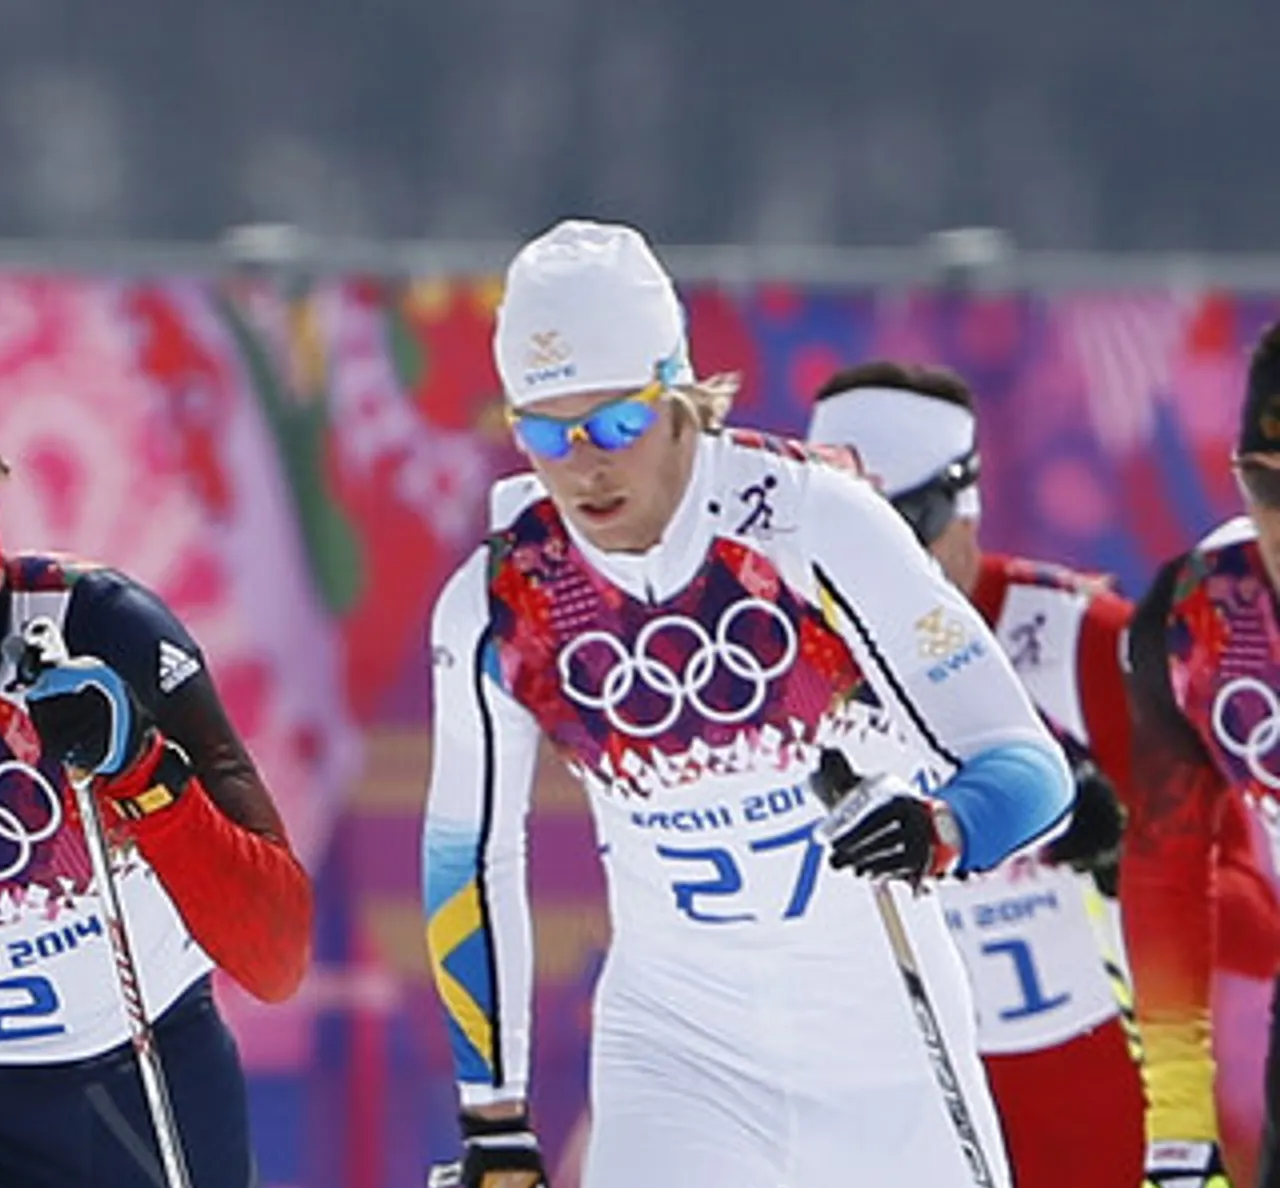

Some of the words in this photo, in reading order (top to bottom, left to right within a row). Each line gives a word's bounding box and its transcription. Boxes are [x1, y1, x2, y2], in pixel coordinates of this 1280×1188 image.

[743, 785, 806, 823] 201
[656, 816, 827, 924] 27
[7, 914, 103, 970] 2014
[981, 937, 1072, 1021] 1
